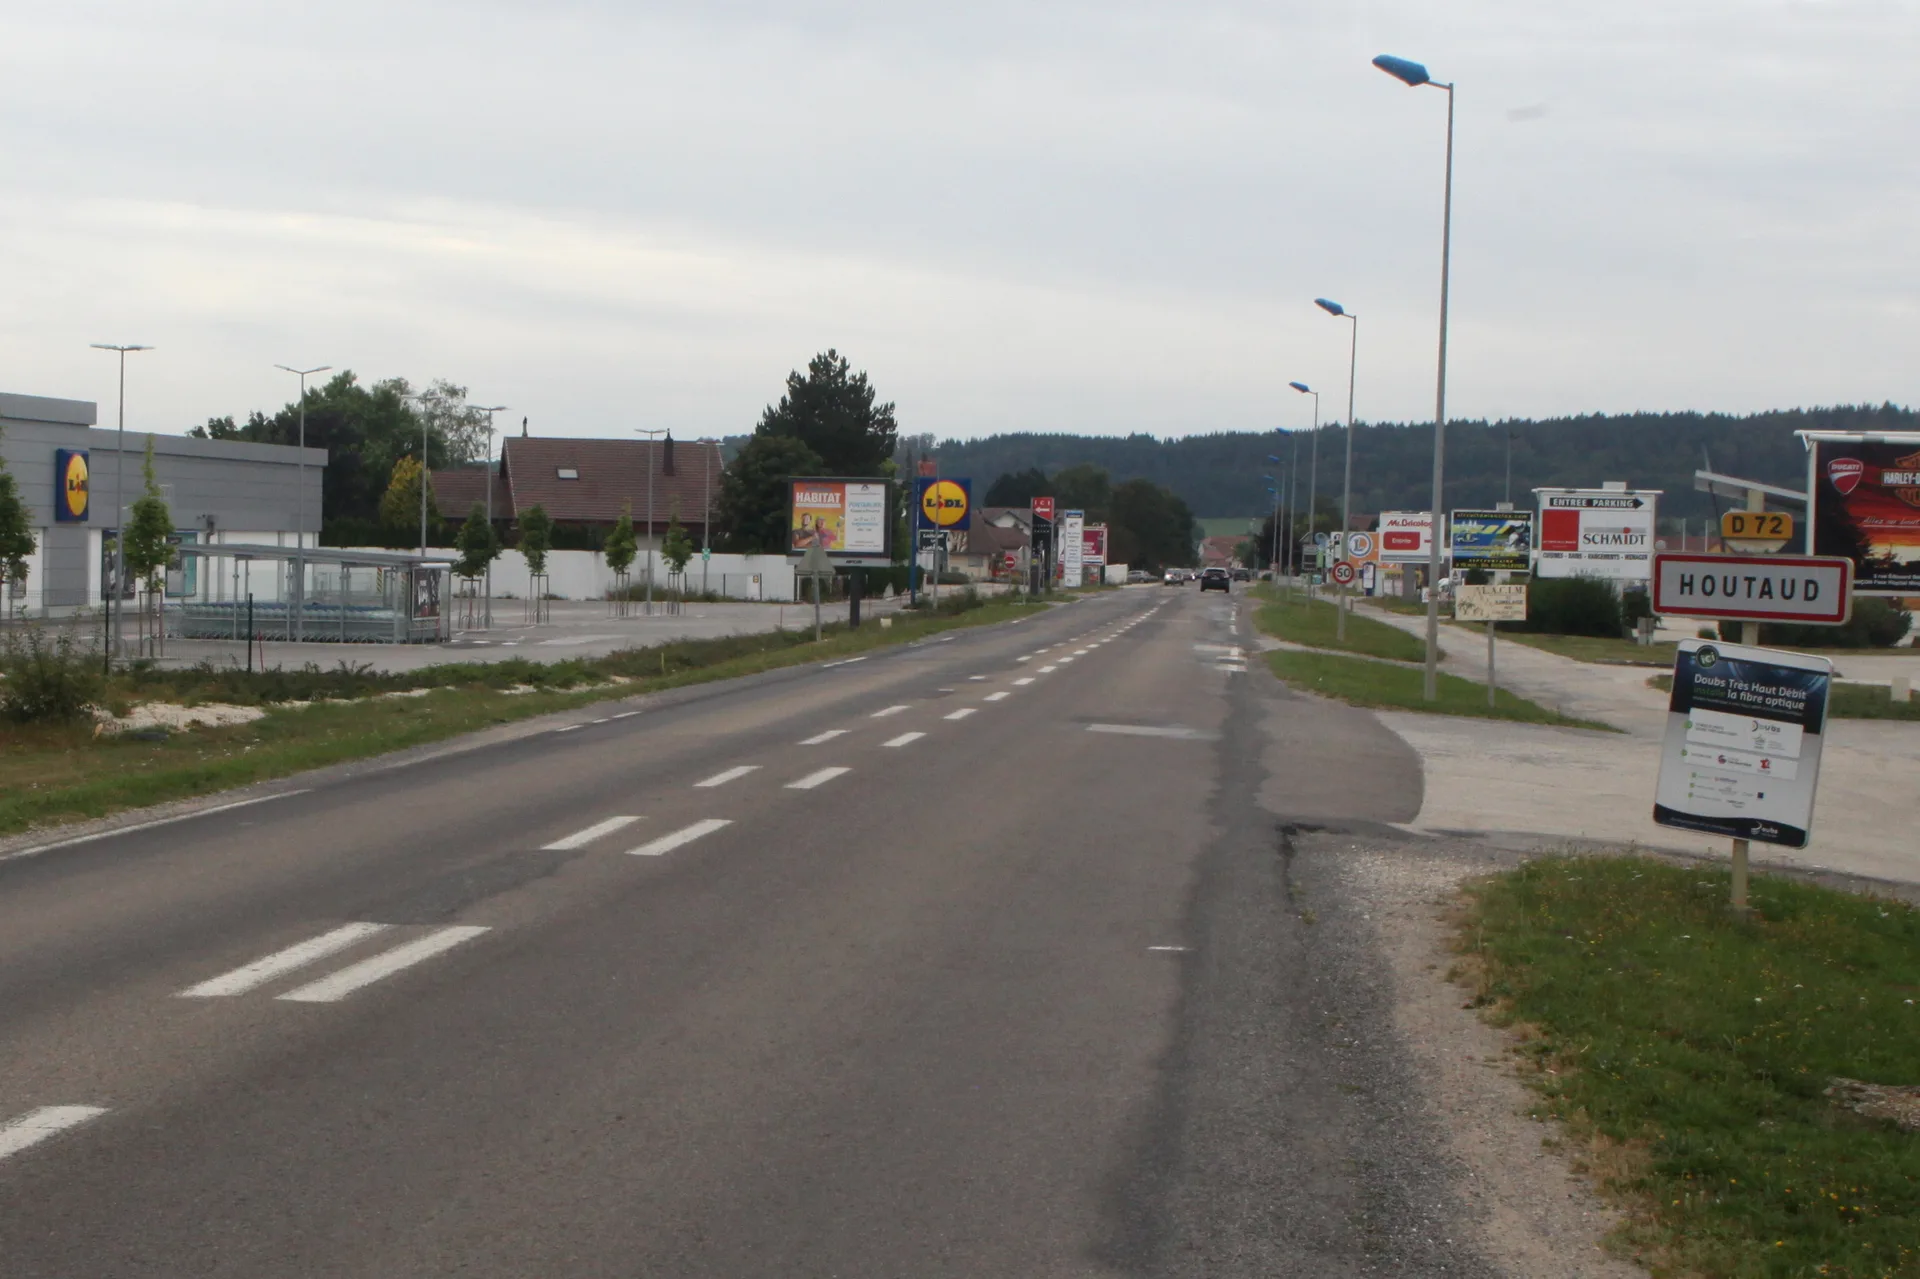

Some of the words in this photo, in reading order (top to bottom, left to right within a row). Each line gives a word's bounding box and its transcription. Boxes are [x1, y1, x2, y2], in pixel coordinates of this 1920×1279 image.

[796, 492, 841, 503] HABITAT
[1553, 499, 1587, 507] ENTREE
[1731, 516, 1745, 534] D
[1755, 516, 1784, 534] 72
[1582, 527, 1647, 545] SCHMIDT
[1336, 568, 1351, 578] 50
[1680, 573, 1820, 601] HOUTAUD
[1694, 674, 1726, 687] Doubs
[1729, 679, 1749, 691] Très
[1751, 682, 1777, 695] Haut
[1778, 686, 1807, 700] Débit
[1727, 689, 1737, 699] la
[1740, 691, 1762, 704] fibre
[1765, 696, 1805, 710] optique
